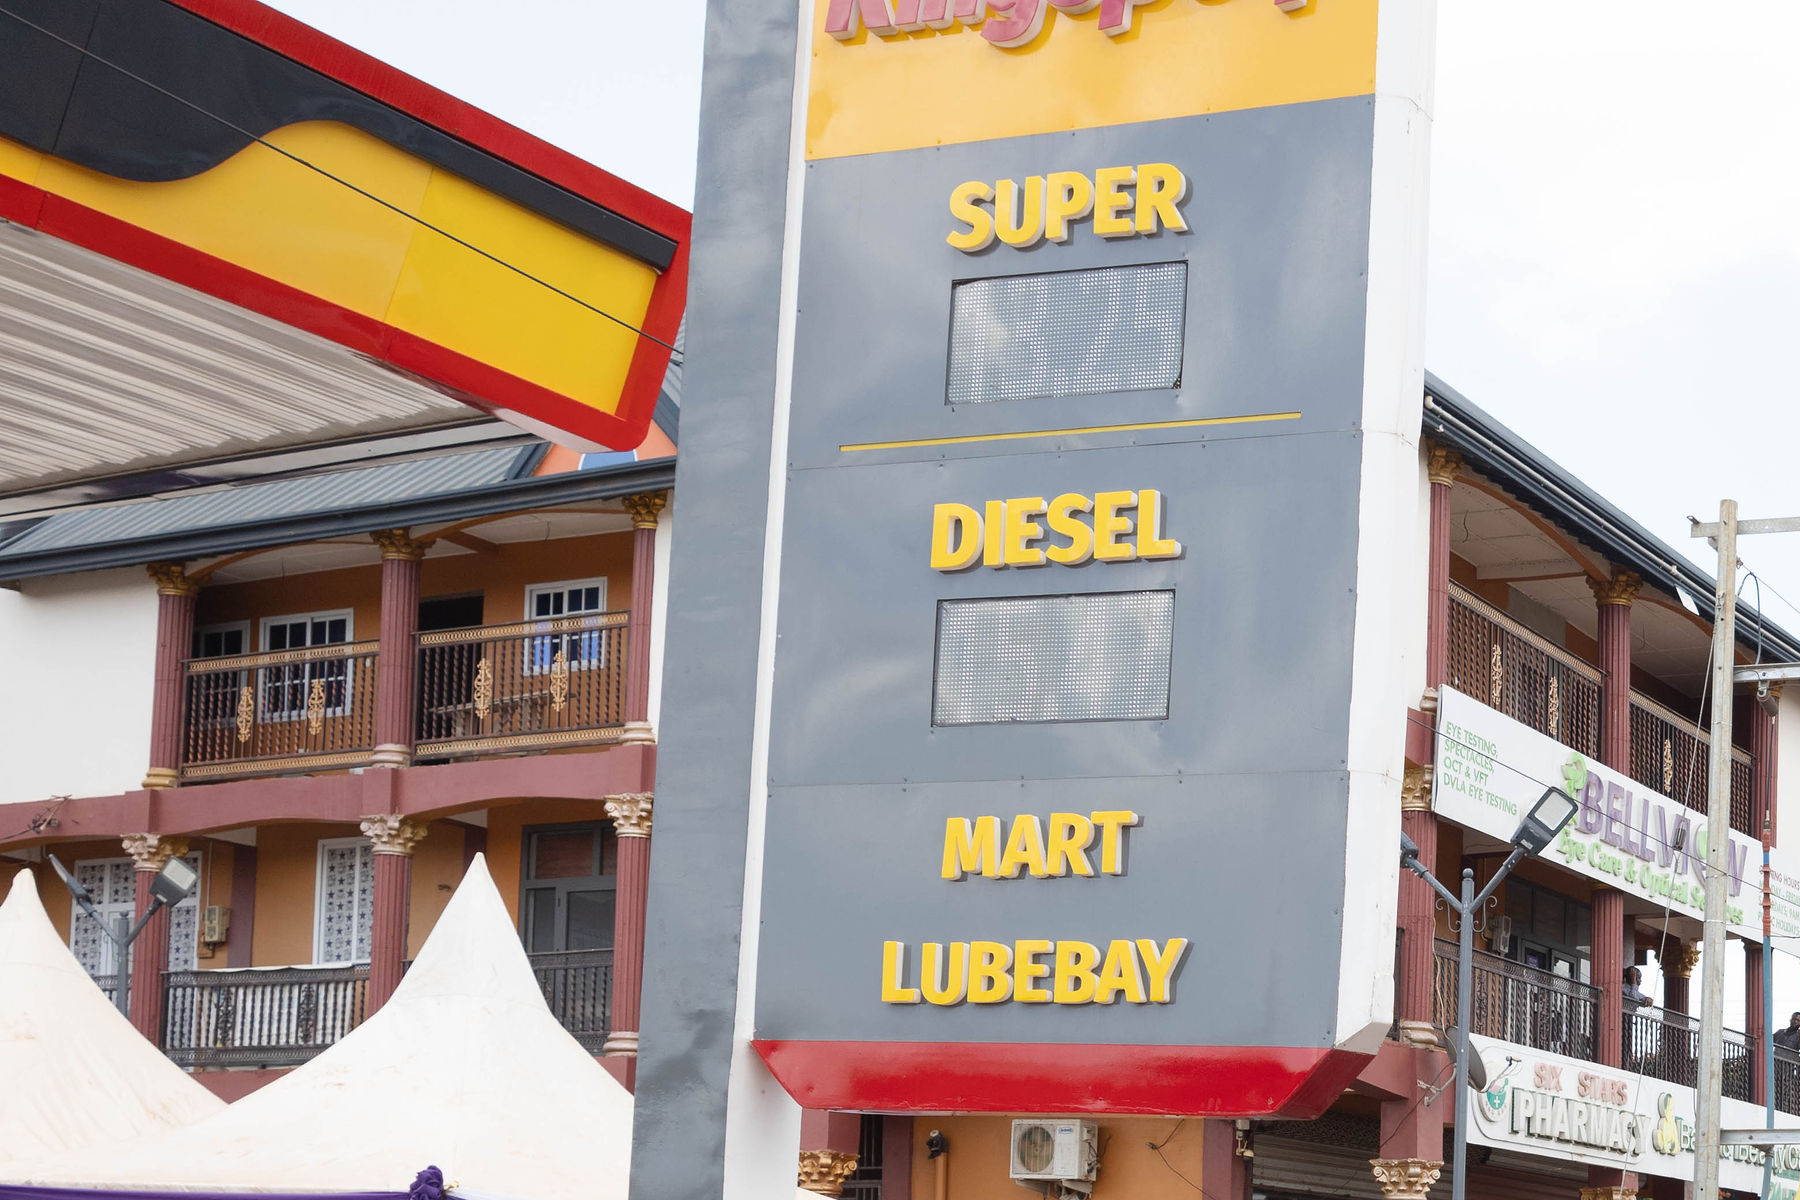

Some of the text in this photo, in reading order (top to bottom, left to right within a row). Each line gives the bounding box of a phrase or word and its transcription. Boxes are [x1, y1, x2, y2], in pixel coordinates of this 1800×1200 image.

[946, 162, 1189, 252] SUPER
[930, 489, 1181, 571] DIESEL
[1443, 756, 1463, 774] OCT
[1446, 721, 1461, 740] EYE
[1443, 773, 1517, 816] DVLA EYE TESTING
[941, 811, 1138, 881] MART
[1557, 828, 1586, 863] Eye
[1589, 842, 1623, 877] Care
[1625, 858, 1638, 884] &
[1640, 864, 1689, 904] Optical
[881, 938, 1188, 1006] LUBEBAY
[1534, 1062, 1629, 1106] SIX STARS
[1508, 1086, 1652, 1157] PHARMACY
